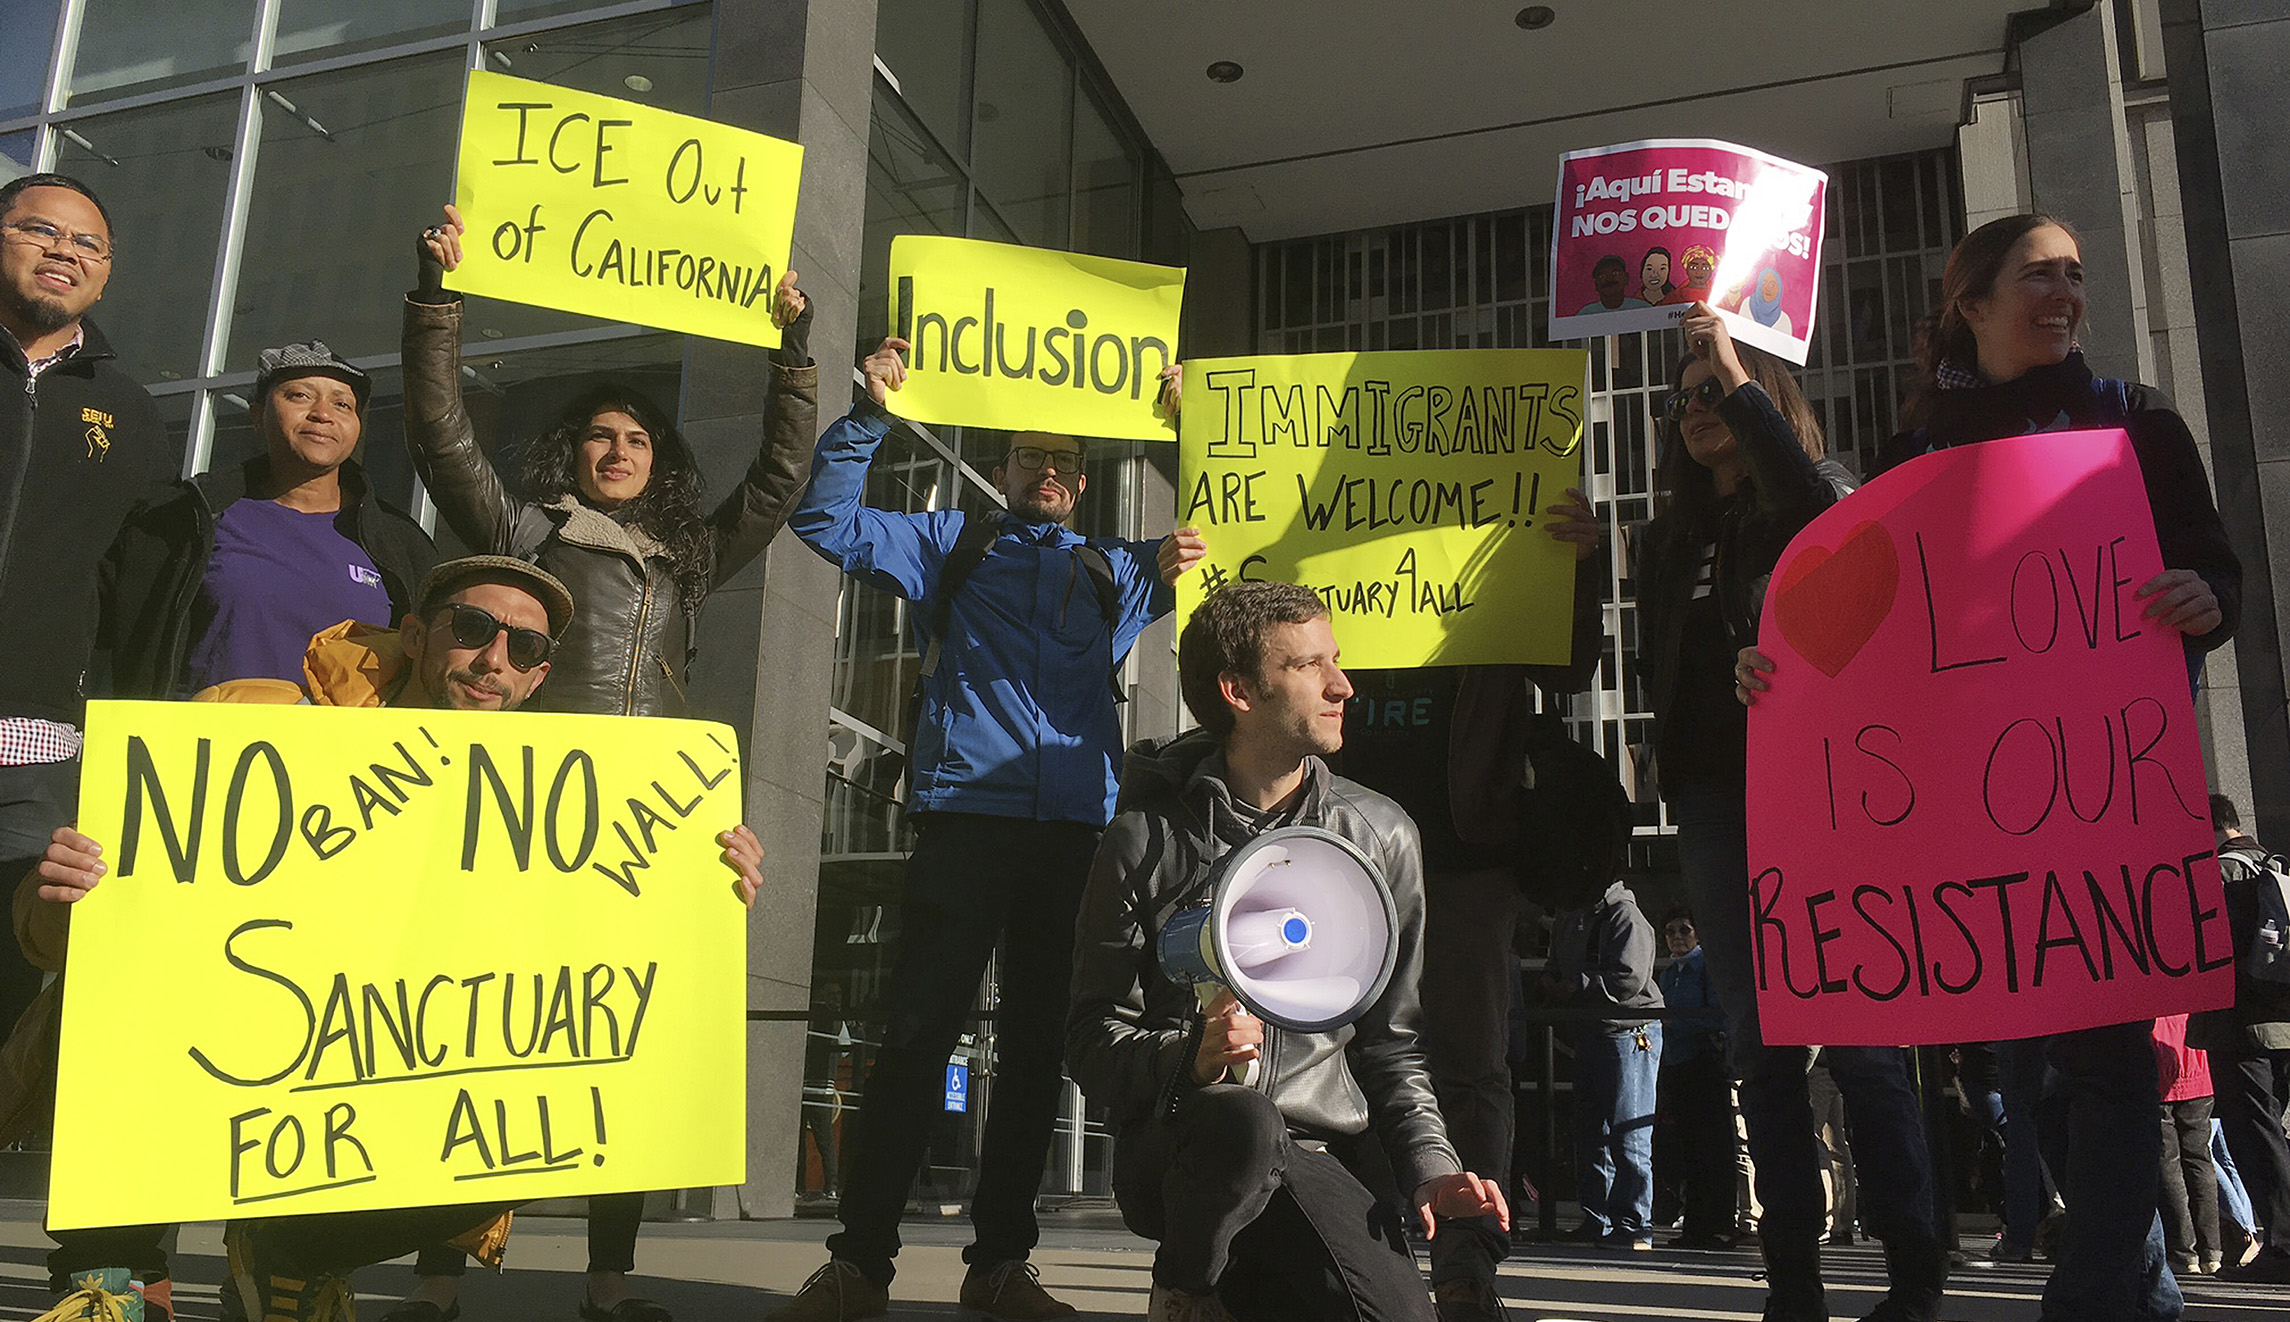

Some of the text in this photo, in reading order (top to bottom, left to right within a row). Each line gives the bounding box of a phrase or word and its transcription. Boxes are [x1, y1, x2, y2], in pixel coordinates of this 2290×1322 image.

[492, 102, 748, 215] ICE Out
[1574, 169, 1662, 210] ¡Aquí
[491, 204, 774, 315] of CALIFORNIA
[1570, 208, 1638, 239] NOS
[897, 275, 1170, 405] Inclusion
[82, 407, 113, 424] SEIU
[1205, 368, 1583, 459] IMMIGRANTS
[1185, 470, 1541, 532] ARE WELCOME!!
[1915, 531, 2142, 674] LOVE
[116, 726, 738, 898] NO BAN! NO WALL!
[1823, 696, 2206, 836] IS OUR
[1747, 849, 2235, 1002] RESISTANCE
[188, 918, 657, 1088] SANCTUARY
[229, 1086, 607, 1199] FOR ALL!
